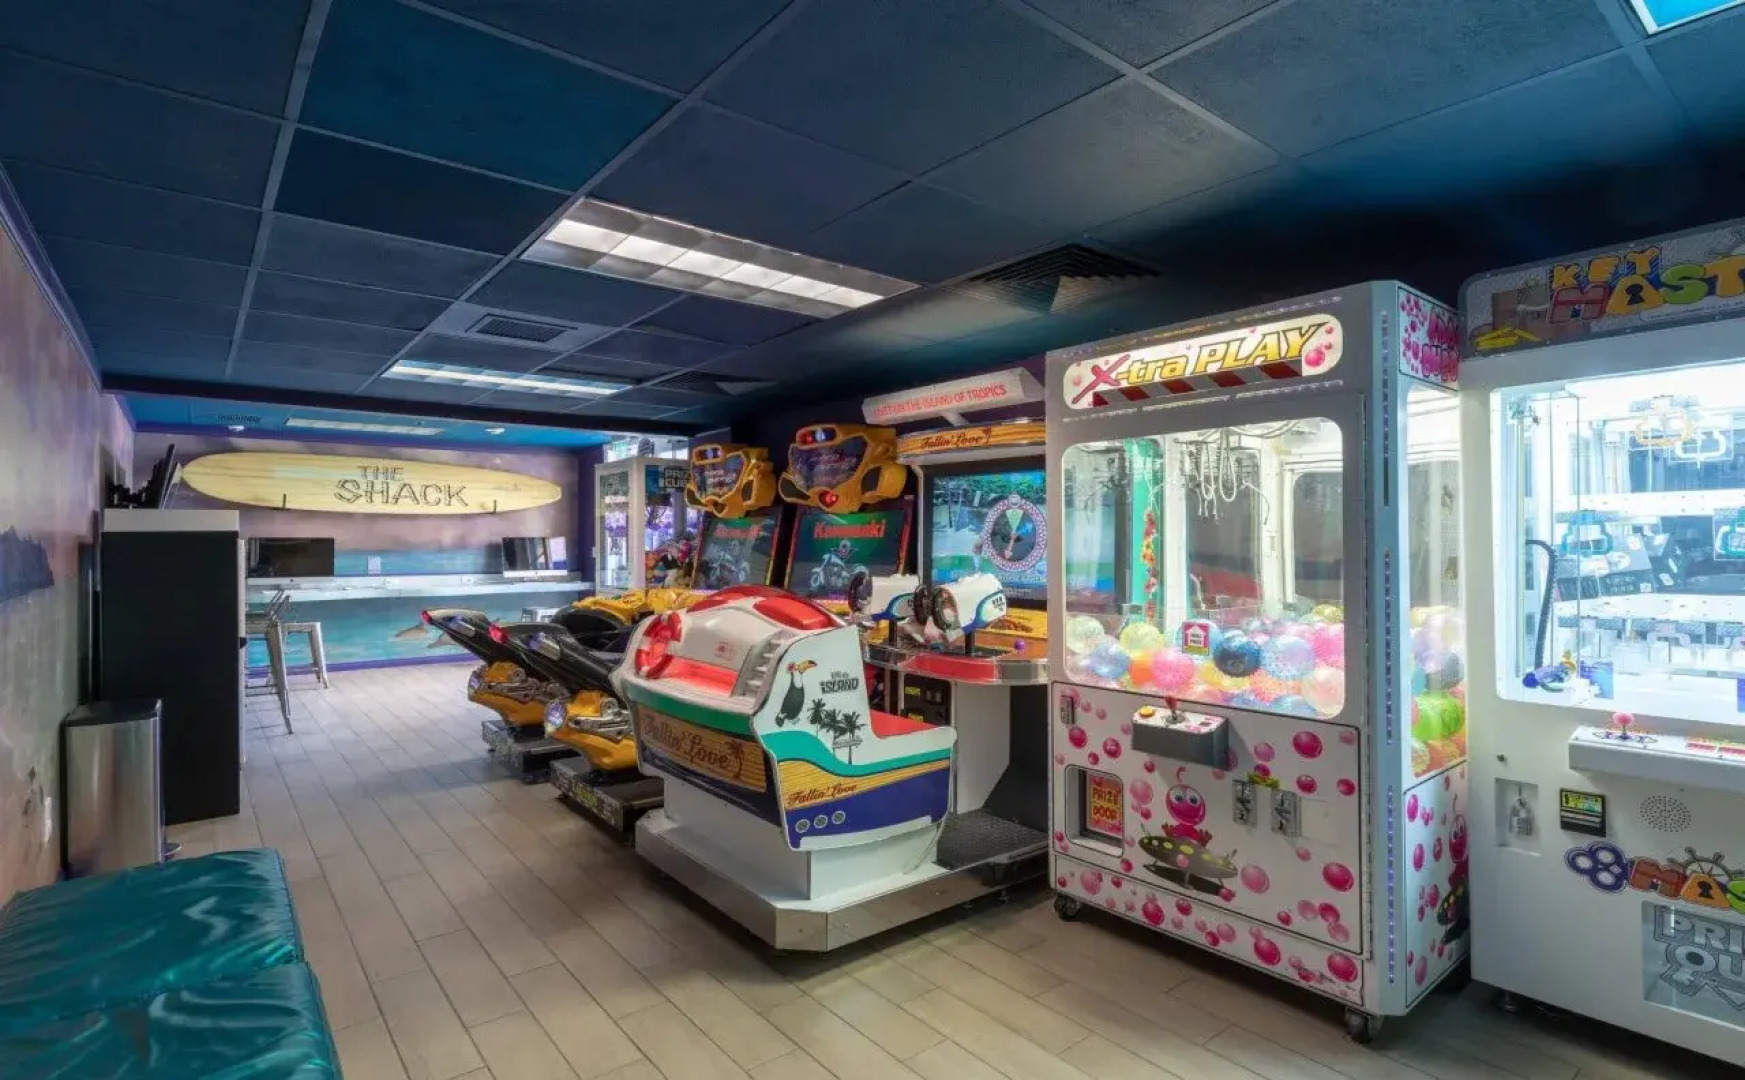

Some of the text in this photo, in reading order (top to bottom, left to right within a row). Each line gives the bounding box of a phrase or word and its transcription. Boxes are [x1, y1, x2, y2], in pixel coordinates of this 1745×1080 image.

[1552, 246, 1661, 289] KEY
[1072, 321, 1329, 404] X-tra PLAY
[954, 391, 965, 403] OF
[967, 383, 1007, 400] TROPICS
[356, 465, 405, 481] THE
[333, 479, 469, 507] SHACK
